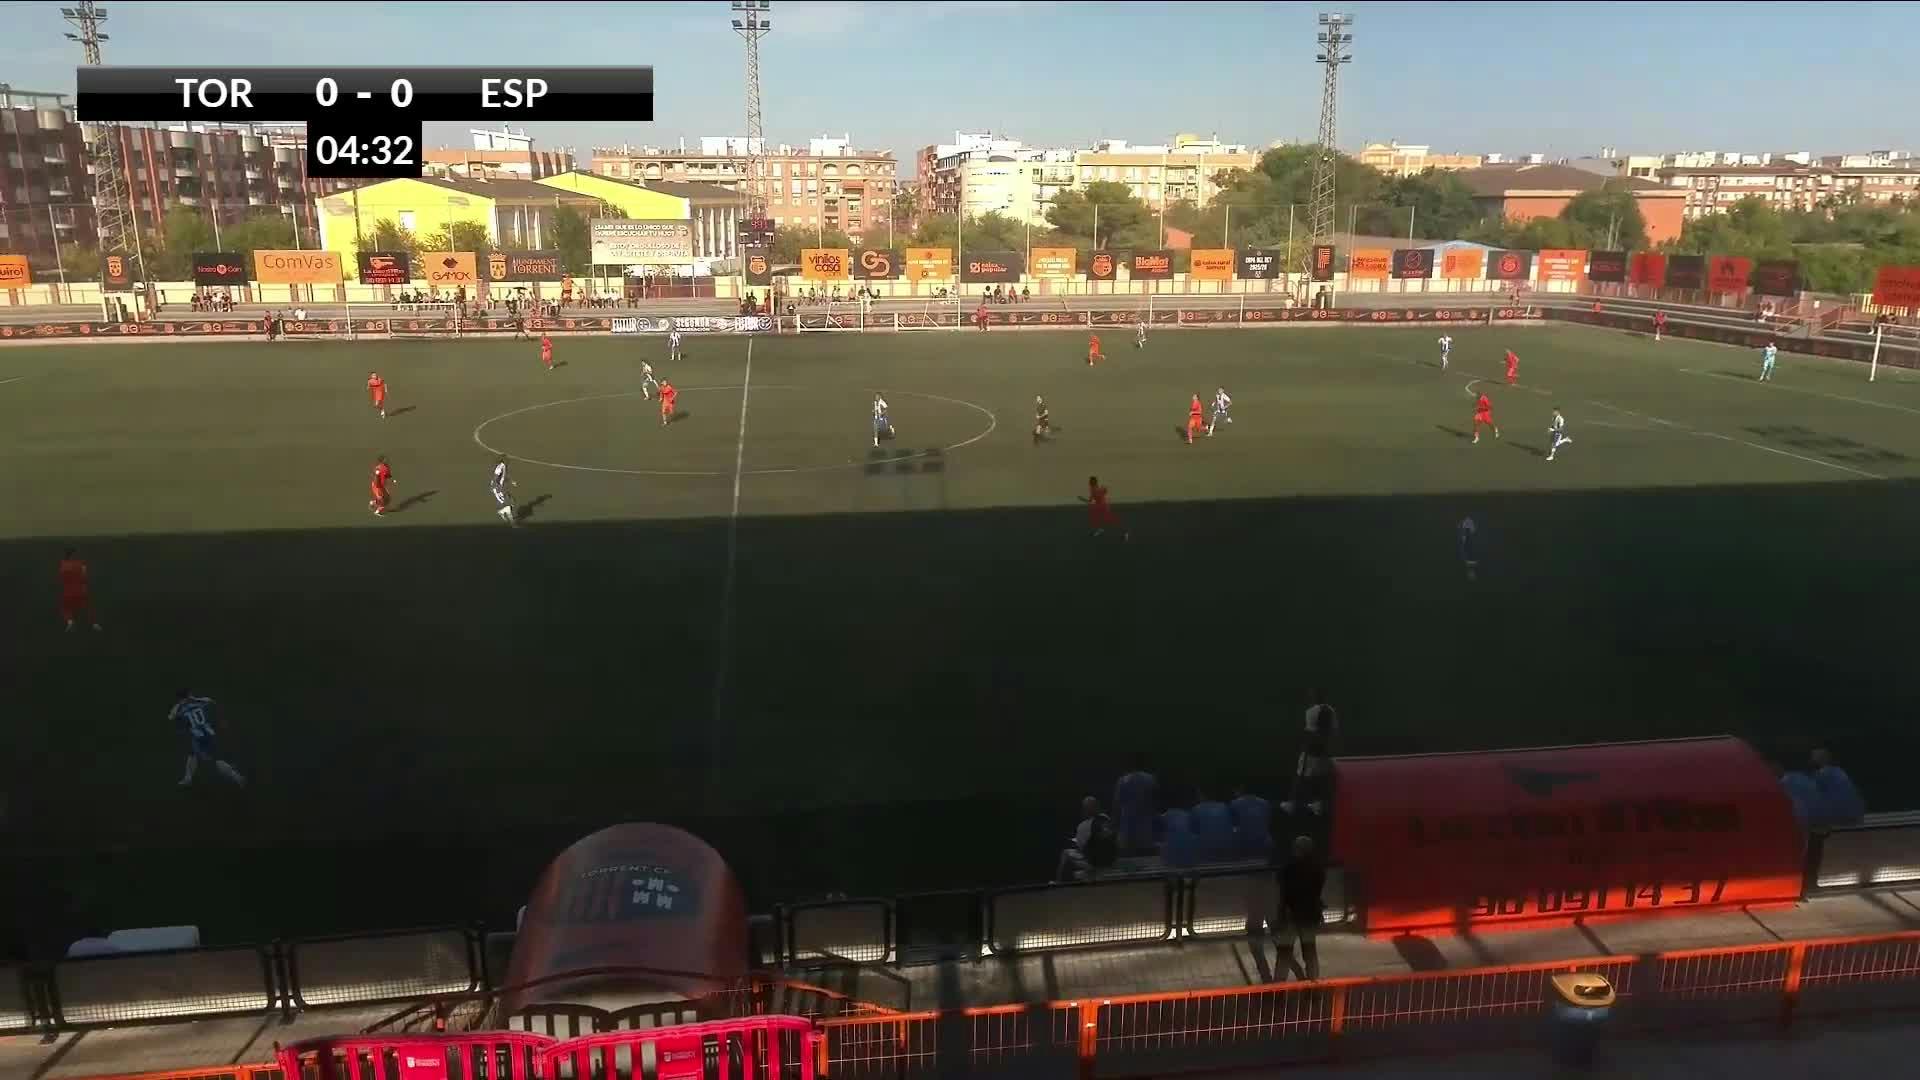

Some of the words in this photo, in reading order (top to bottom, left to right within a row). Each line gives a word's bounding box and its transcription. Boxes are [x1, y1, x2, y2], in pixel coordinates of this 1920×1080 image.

[263, 254, 334, 269] ComVas
[809, 253, 840, 264] vinilos
[512, 264, 557, 273] TORRENT
